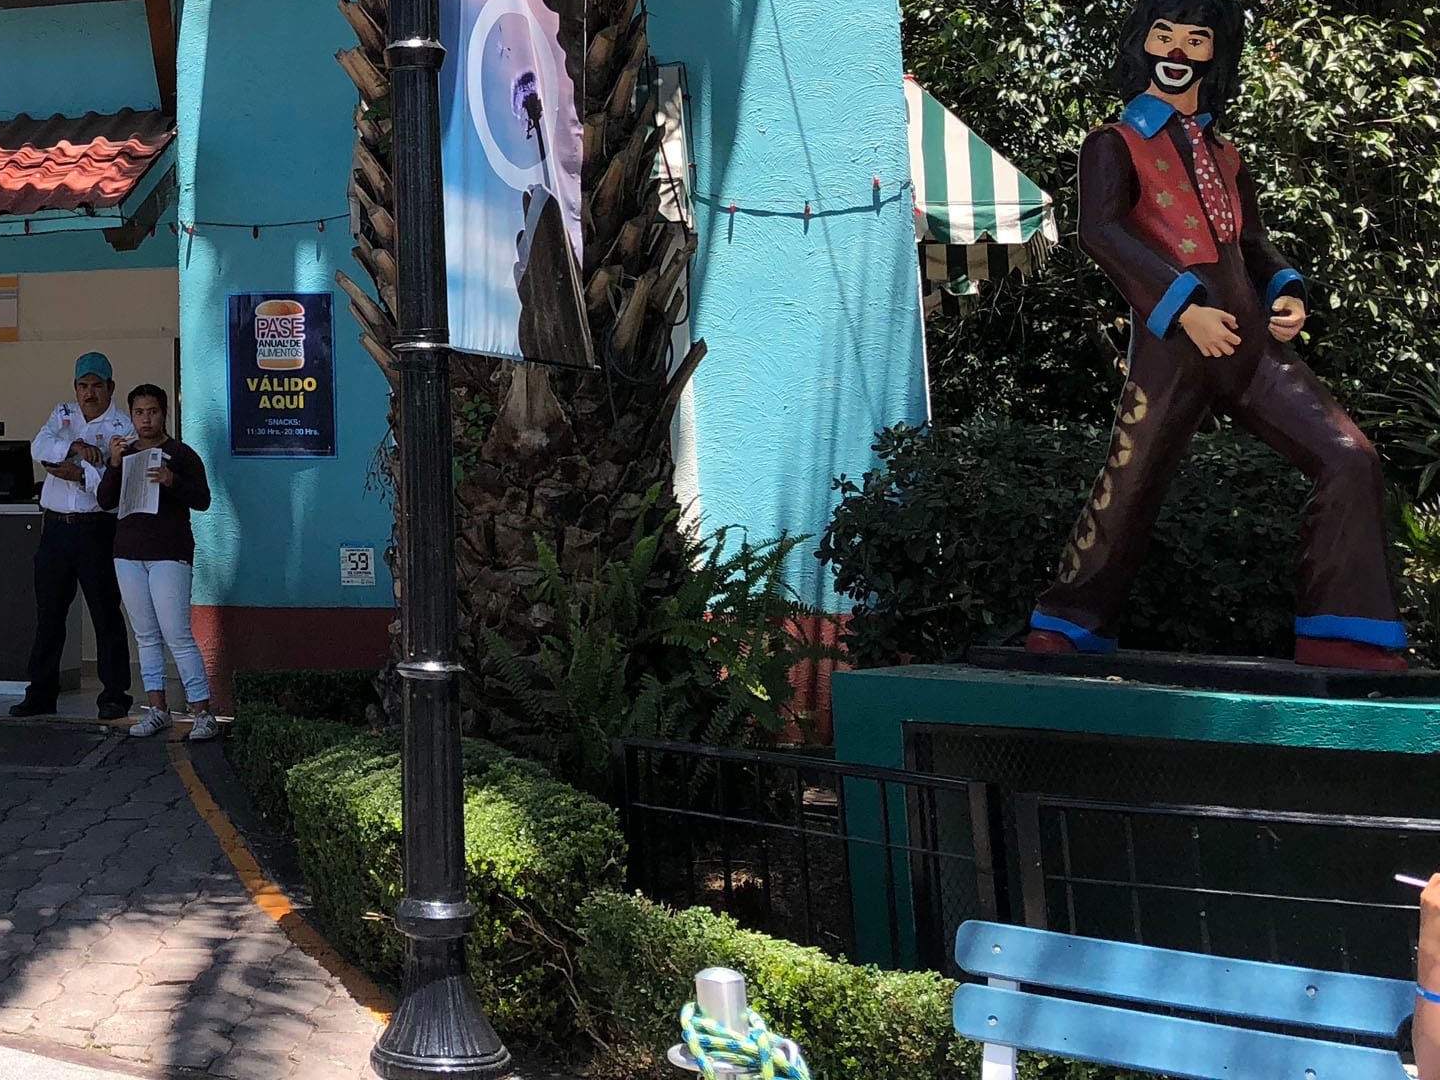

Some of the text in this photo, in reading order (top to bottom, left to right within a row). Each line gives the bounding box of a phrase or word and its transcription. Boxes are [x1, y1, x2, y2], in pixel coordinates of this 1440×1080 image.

[256, 318, 304, 338] PASE
[289, 339, 302, 348] DE
[257, 348, 303, 358] ALIMENTOS
[246, 374, 317, 392] VÁLIDO
[258, 392, 305, 410] AQUÍ
[348, 552, 369, 571] 59
